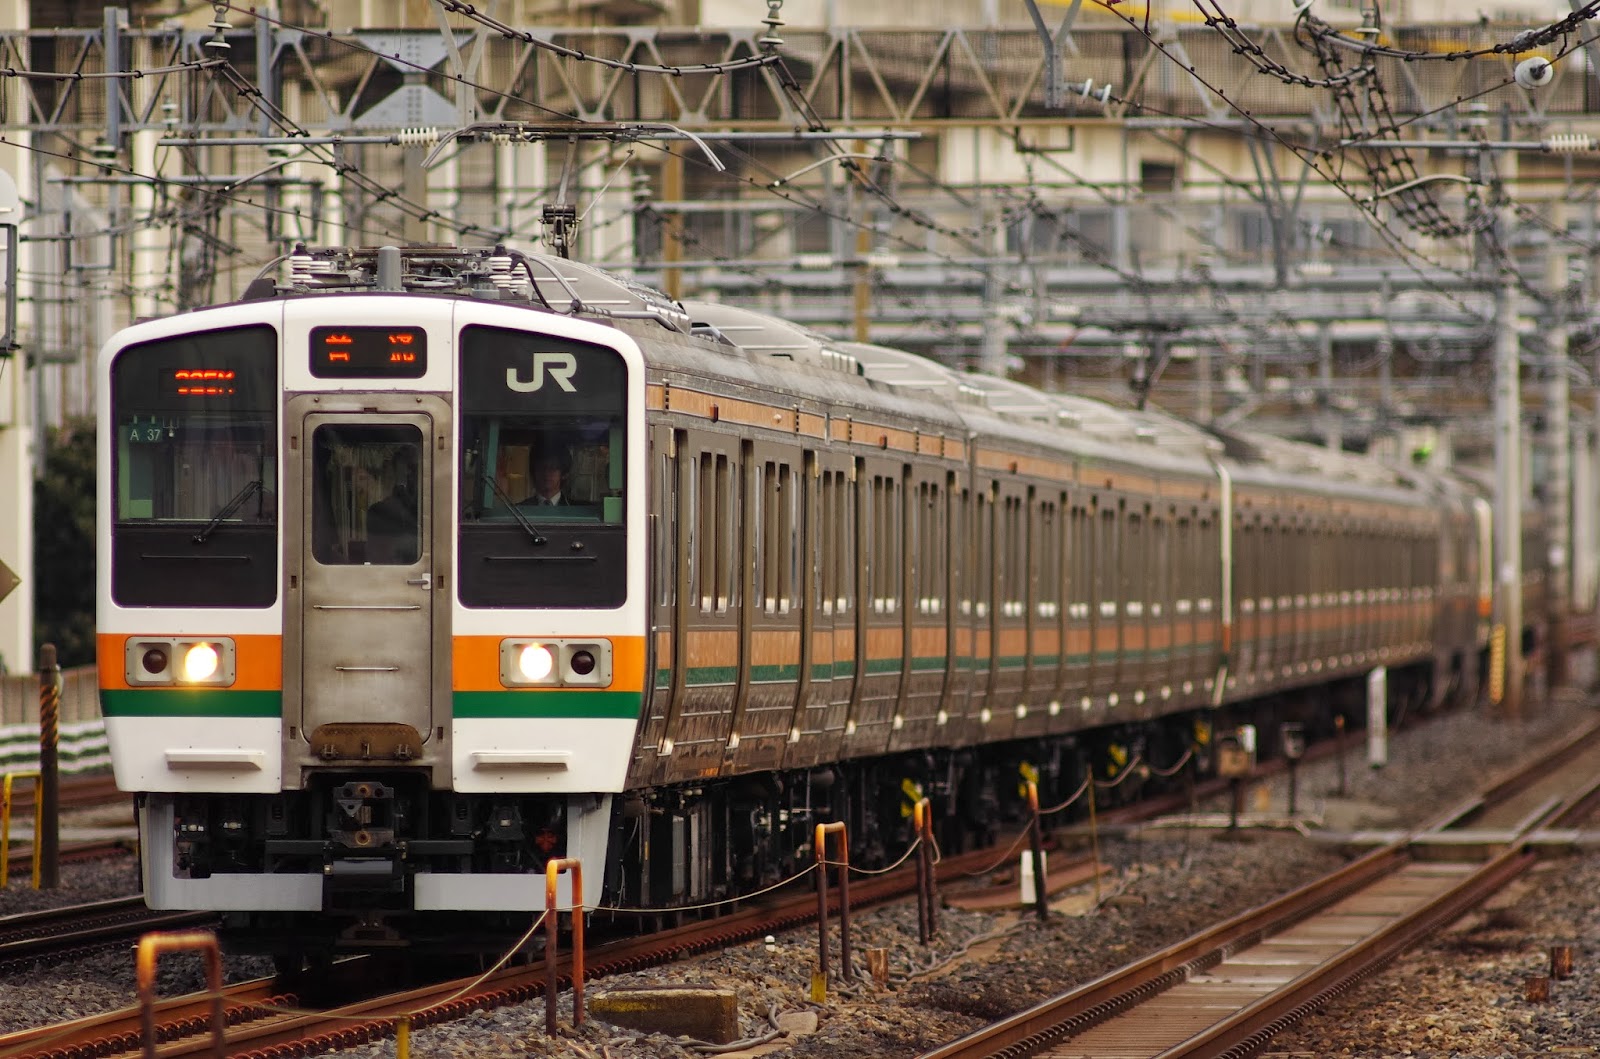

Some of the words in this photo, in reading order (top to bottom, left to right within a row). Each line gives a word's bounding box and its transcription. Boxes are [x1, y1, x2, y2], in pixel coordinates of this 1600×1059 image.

[506, 352, 577, 392] JR
[129, 428, 140, 441] A
[146, 428, 161, 441] 37
